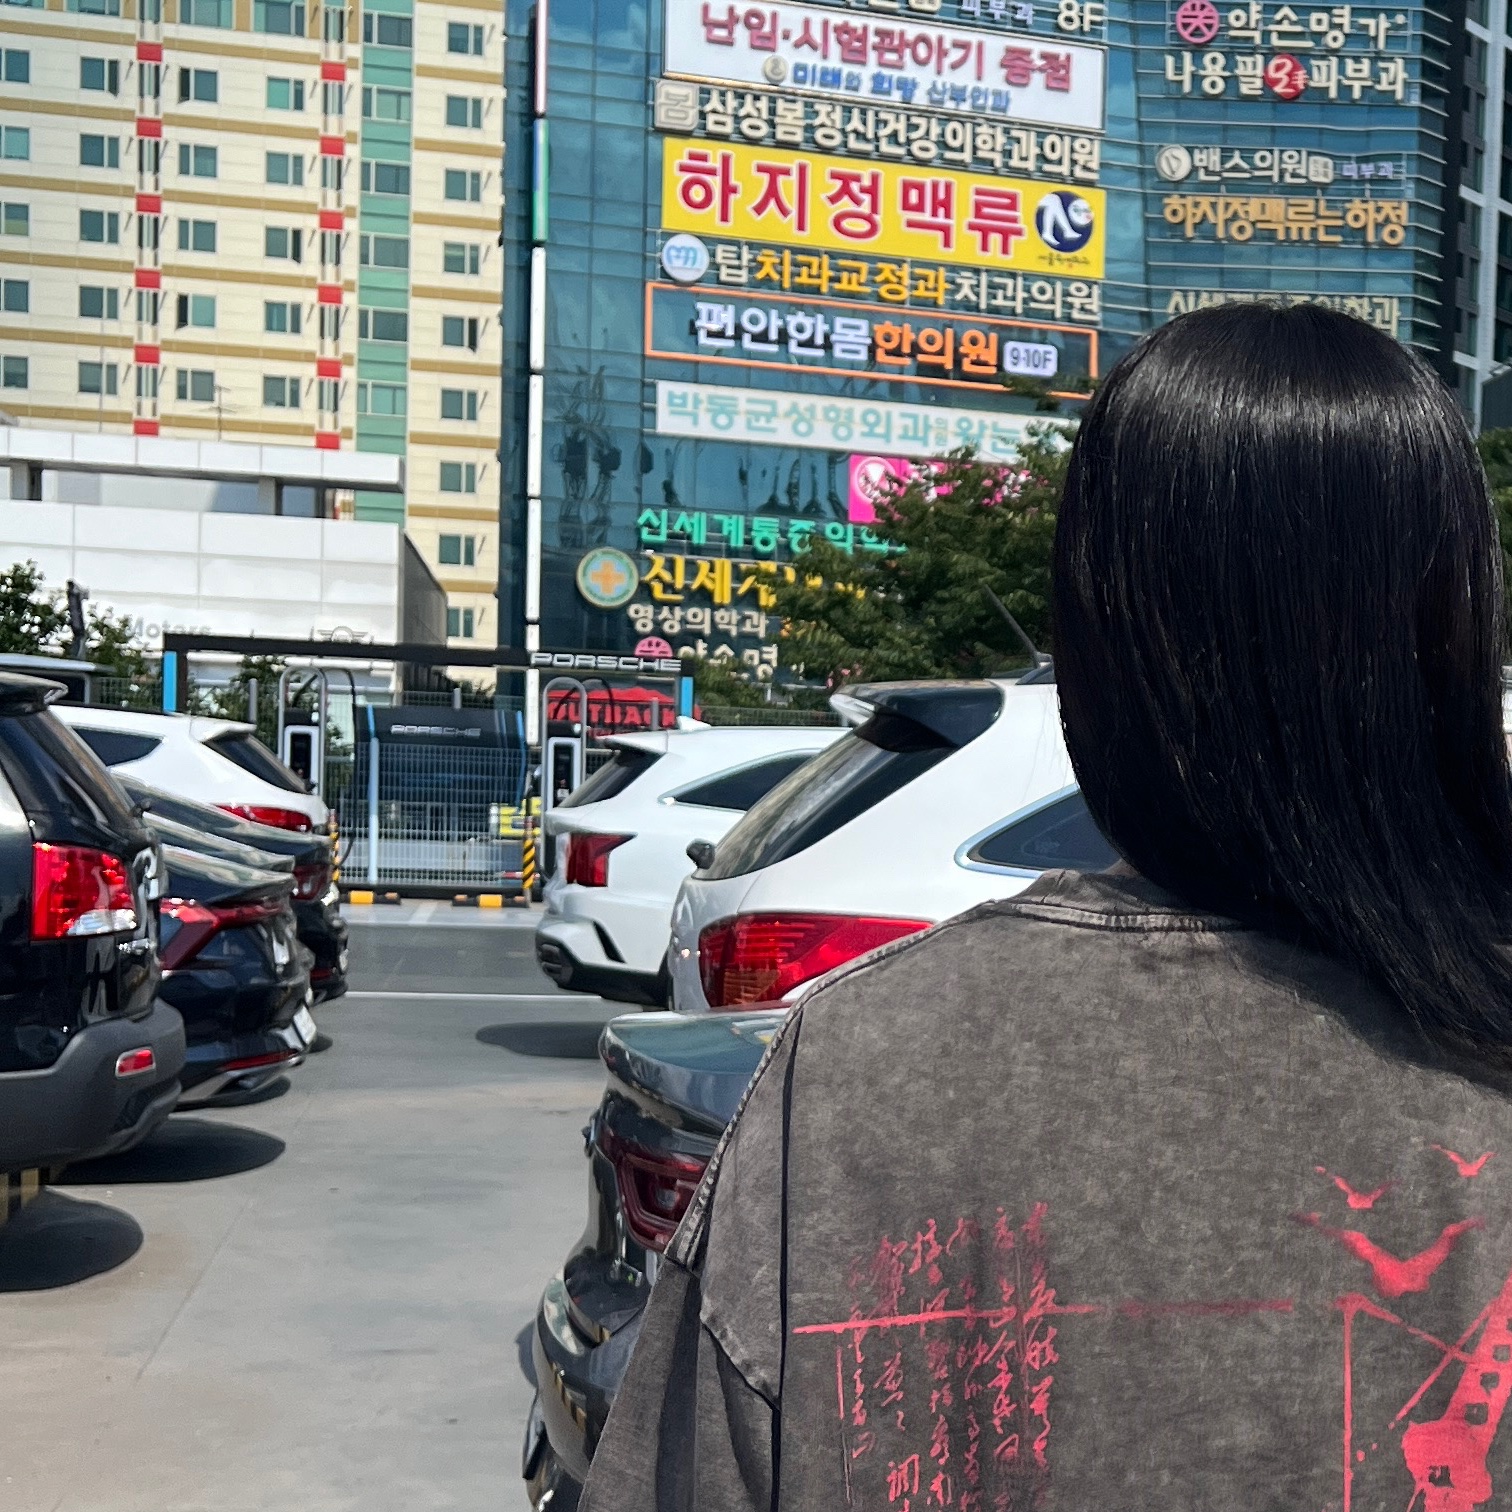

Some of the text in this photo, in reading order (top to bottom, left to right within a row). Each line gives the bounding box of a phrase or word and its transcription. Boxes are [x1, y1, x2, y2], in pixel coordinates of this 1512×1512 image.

[1057, 0, 1105, 32] 8F
[1227, 5, 1391, 50] 약손명가
[1000, 45, 1072, 92] 중점
[1164, 51, 1264, 95] 나용필
[1309, 55, 1408, 100] 피부과
[703, 88, 1099, 180] 삼성봄정신건강의학과의원
[1193, 147, 1308, 183] 밴스의원
[676, 146, 1028, 258] 하지정맥류
[714, 243, 1101, 322] 탑치과교정과치과의원
[695, 301, 998, 376] 편안한몸한의원
[667, 391, 930, 448] 박동균성형외과
[627, 602, 770, 639] 영상의학과
[530, 653, 682, 672] PORSCHE
[391, 724, 481, 736] PORSCHE
